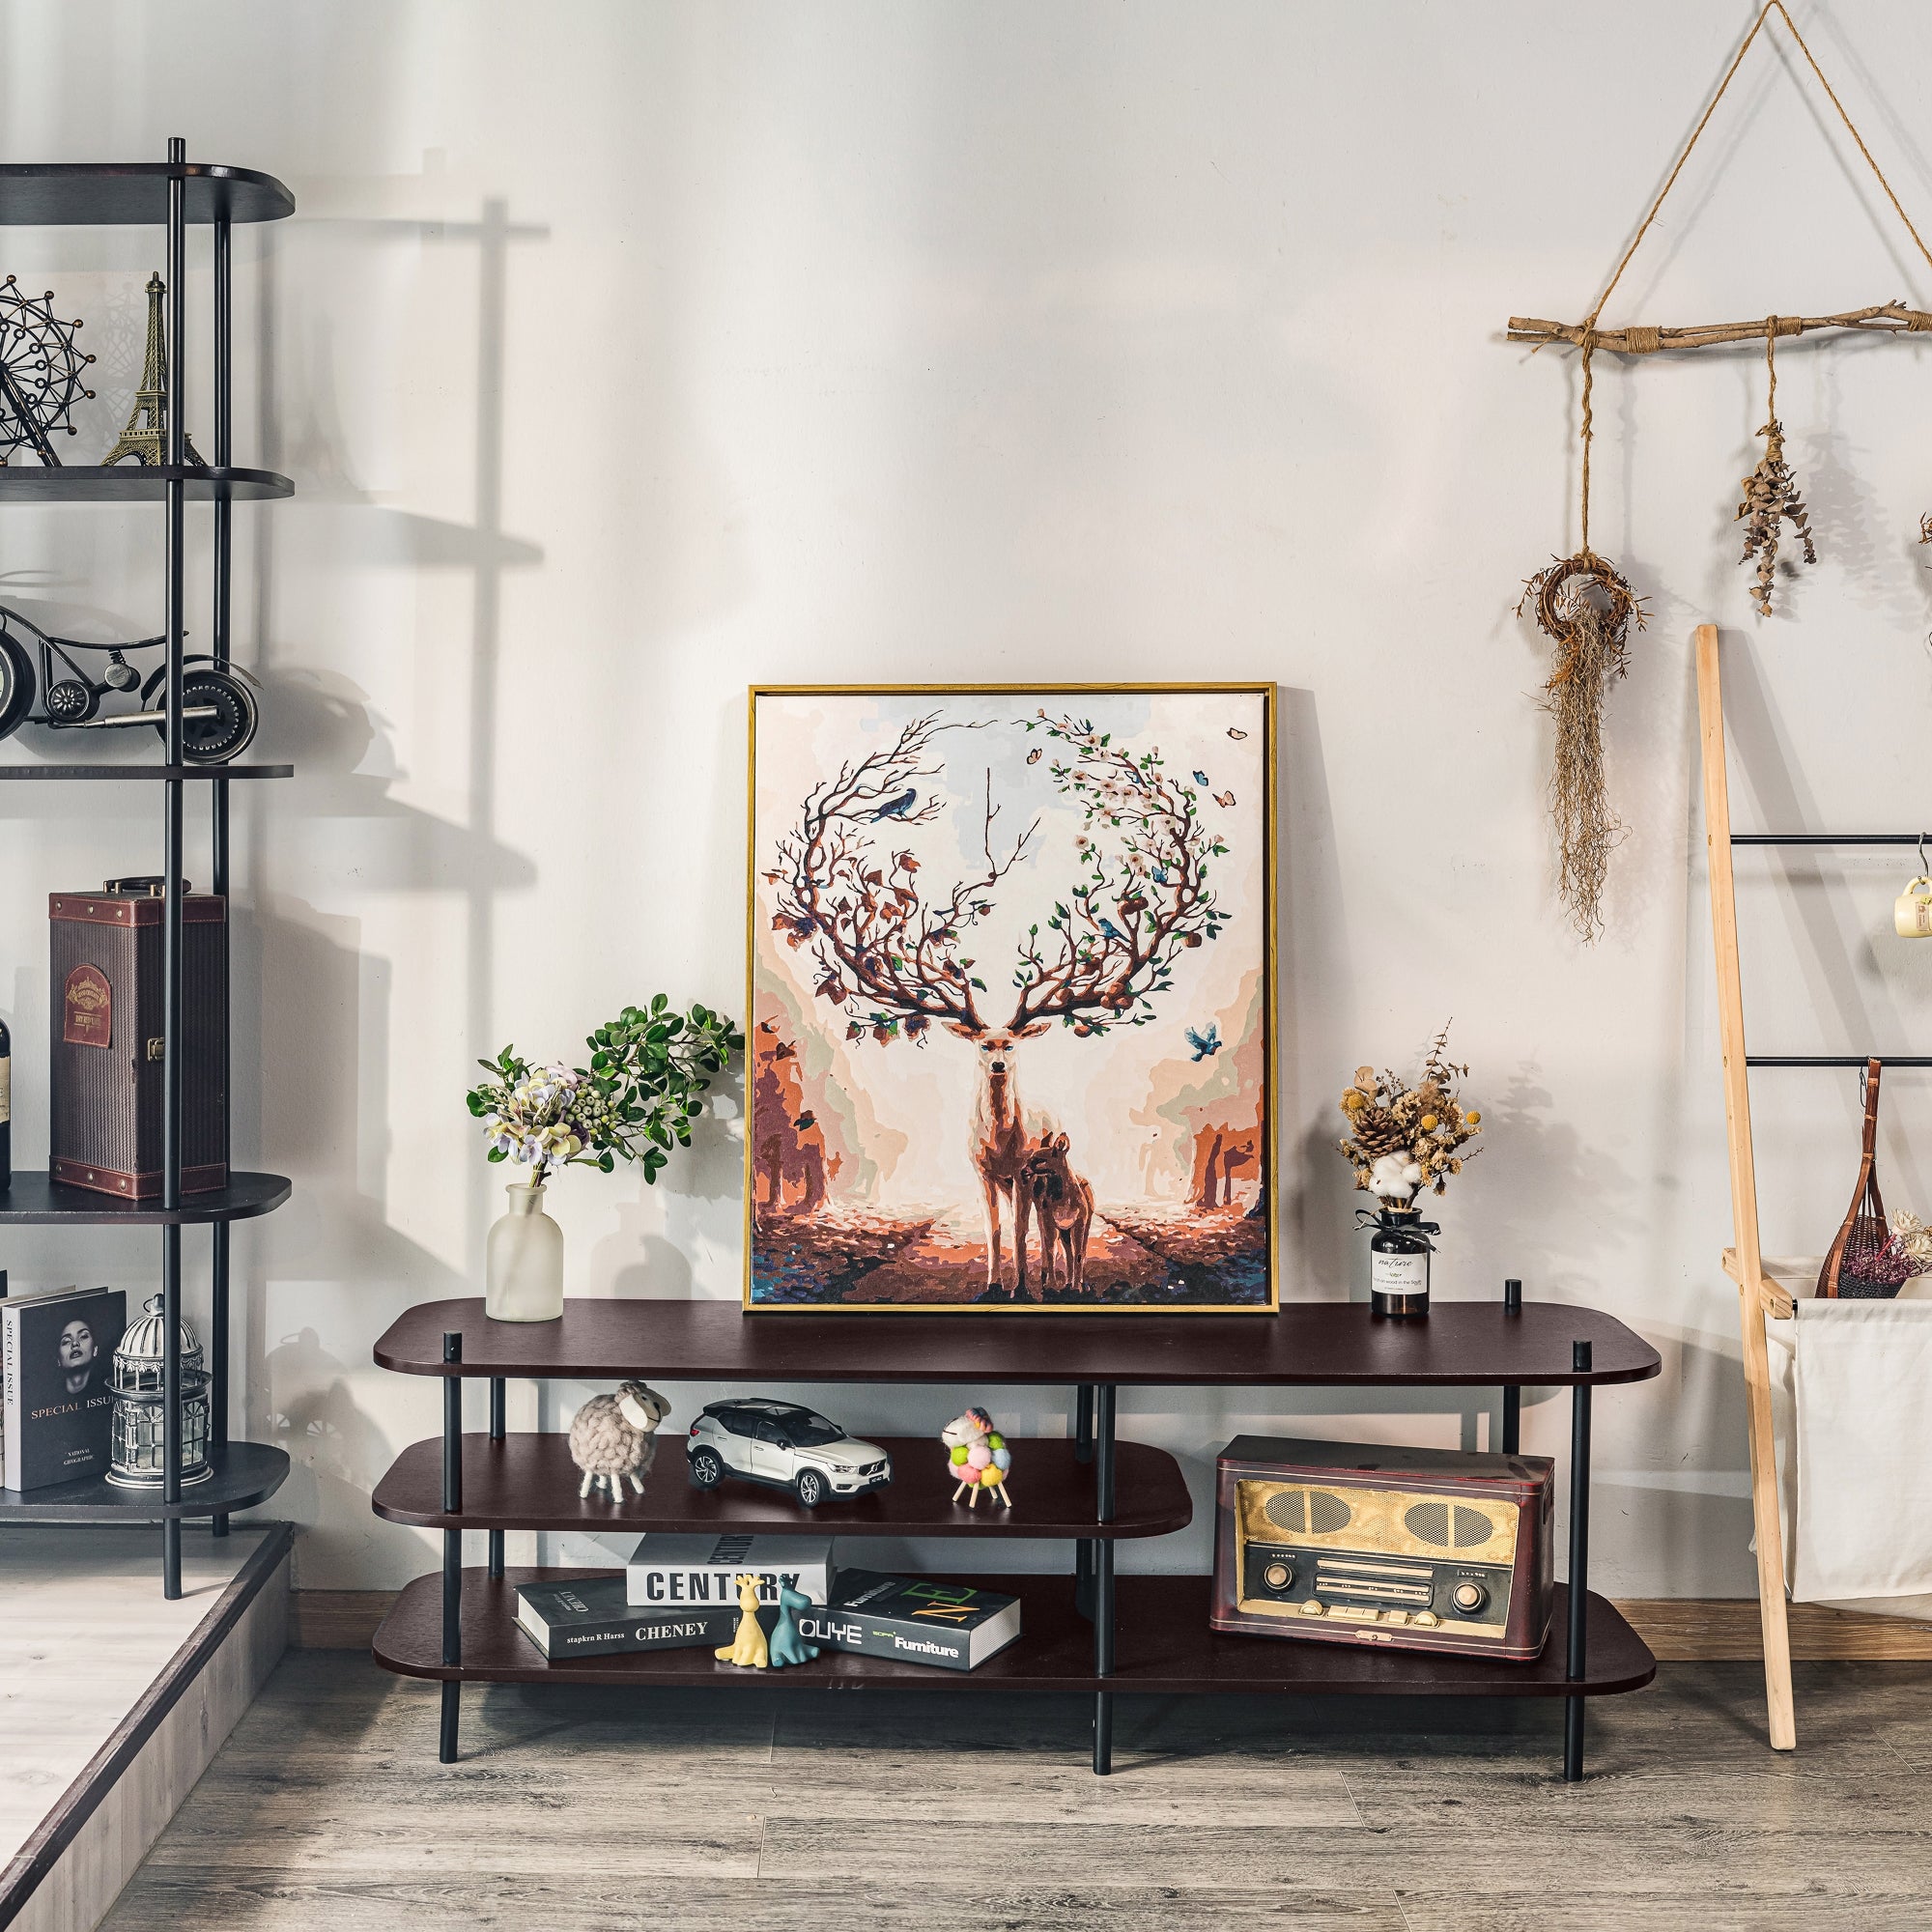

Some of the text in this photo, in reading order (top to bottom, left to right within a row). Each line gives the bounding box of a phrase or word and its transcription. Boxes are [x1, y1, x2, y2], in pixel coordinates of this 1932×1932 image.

[31, 1402, 83, 1420] SPECIAL
[635, 1621, 709, 1641] CHENEY
[895, 1635, 959, 1659] Furniture
